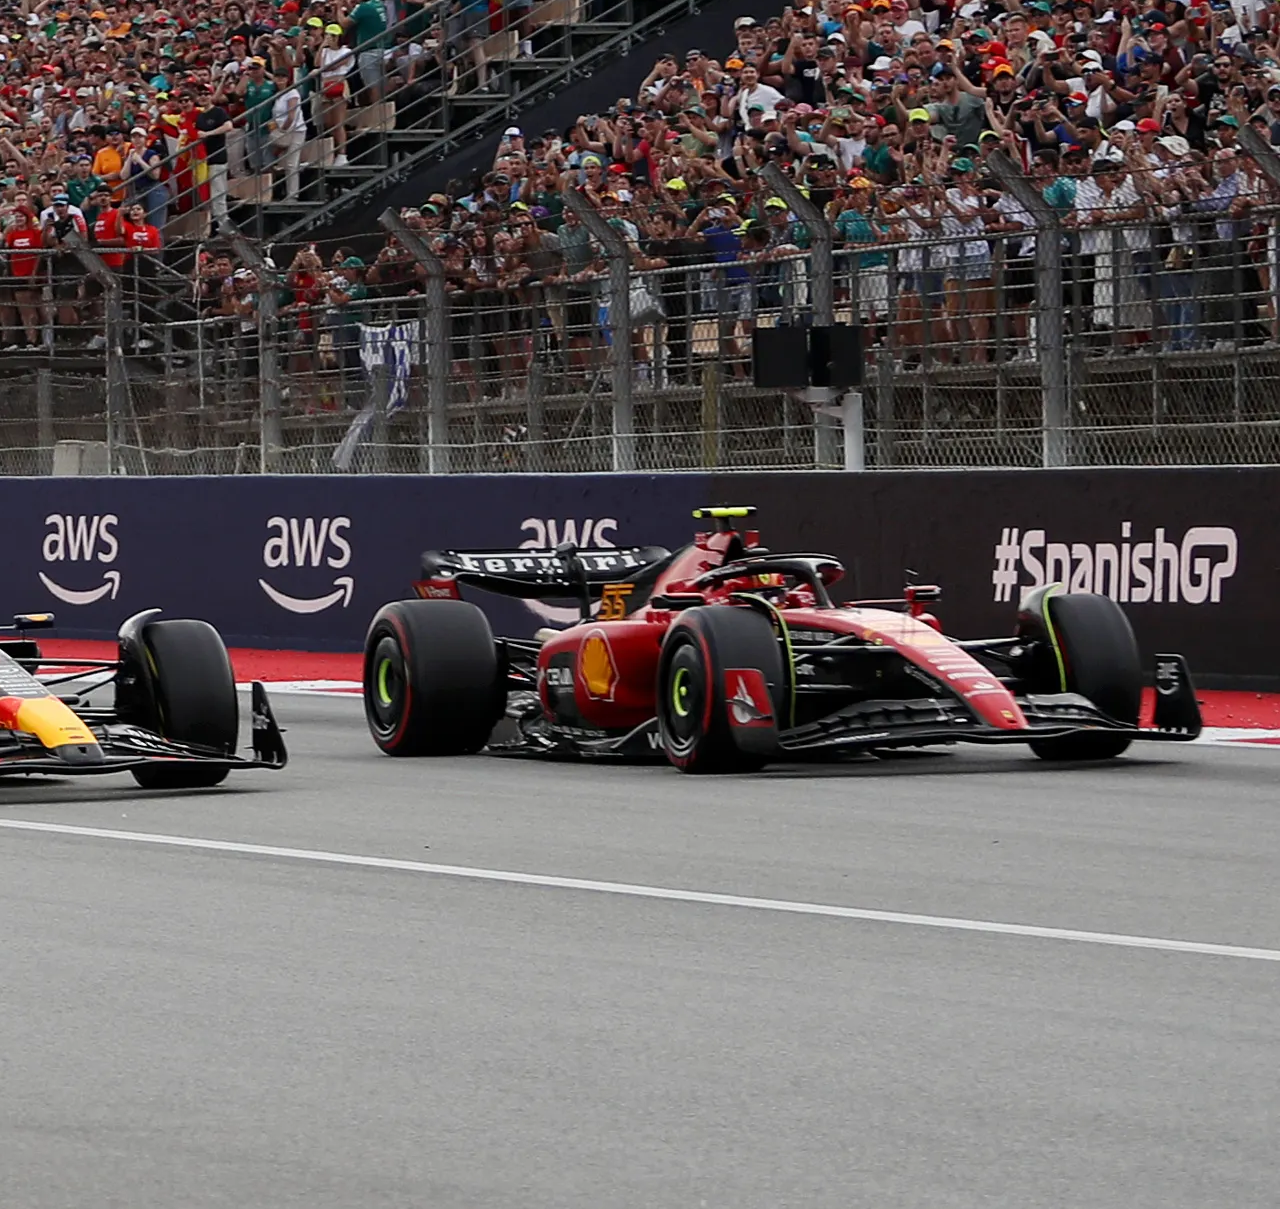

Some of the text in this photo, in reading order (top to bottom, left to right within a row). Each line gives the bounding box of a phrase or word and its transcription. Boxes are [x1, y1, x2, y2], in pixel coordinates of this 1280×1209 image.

[42, 514, 118, 563] aws
[263, 516, 351, 568] aws
[993, 522, 1238, 604] #SpanishGP
